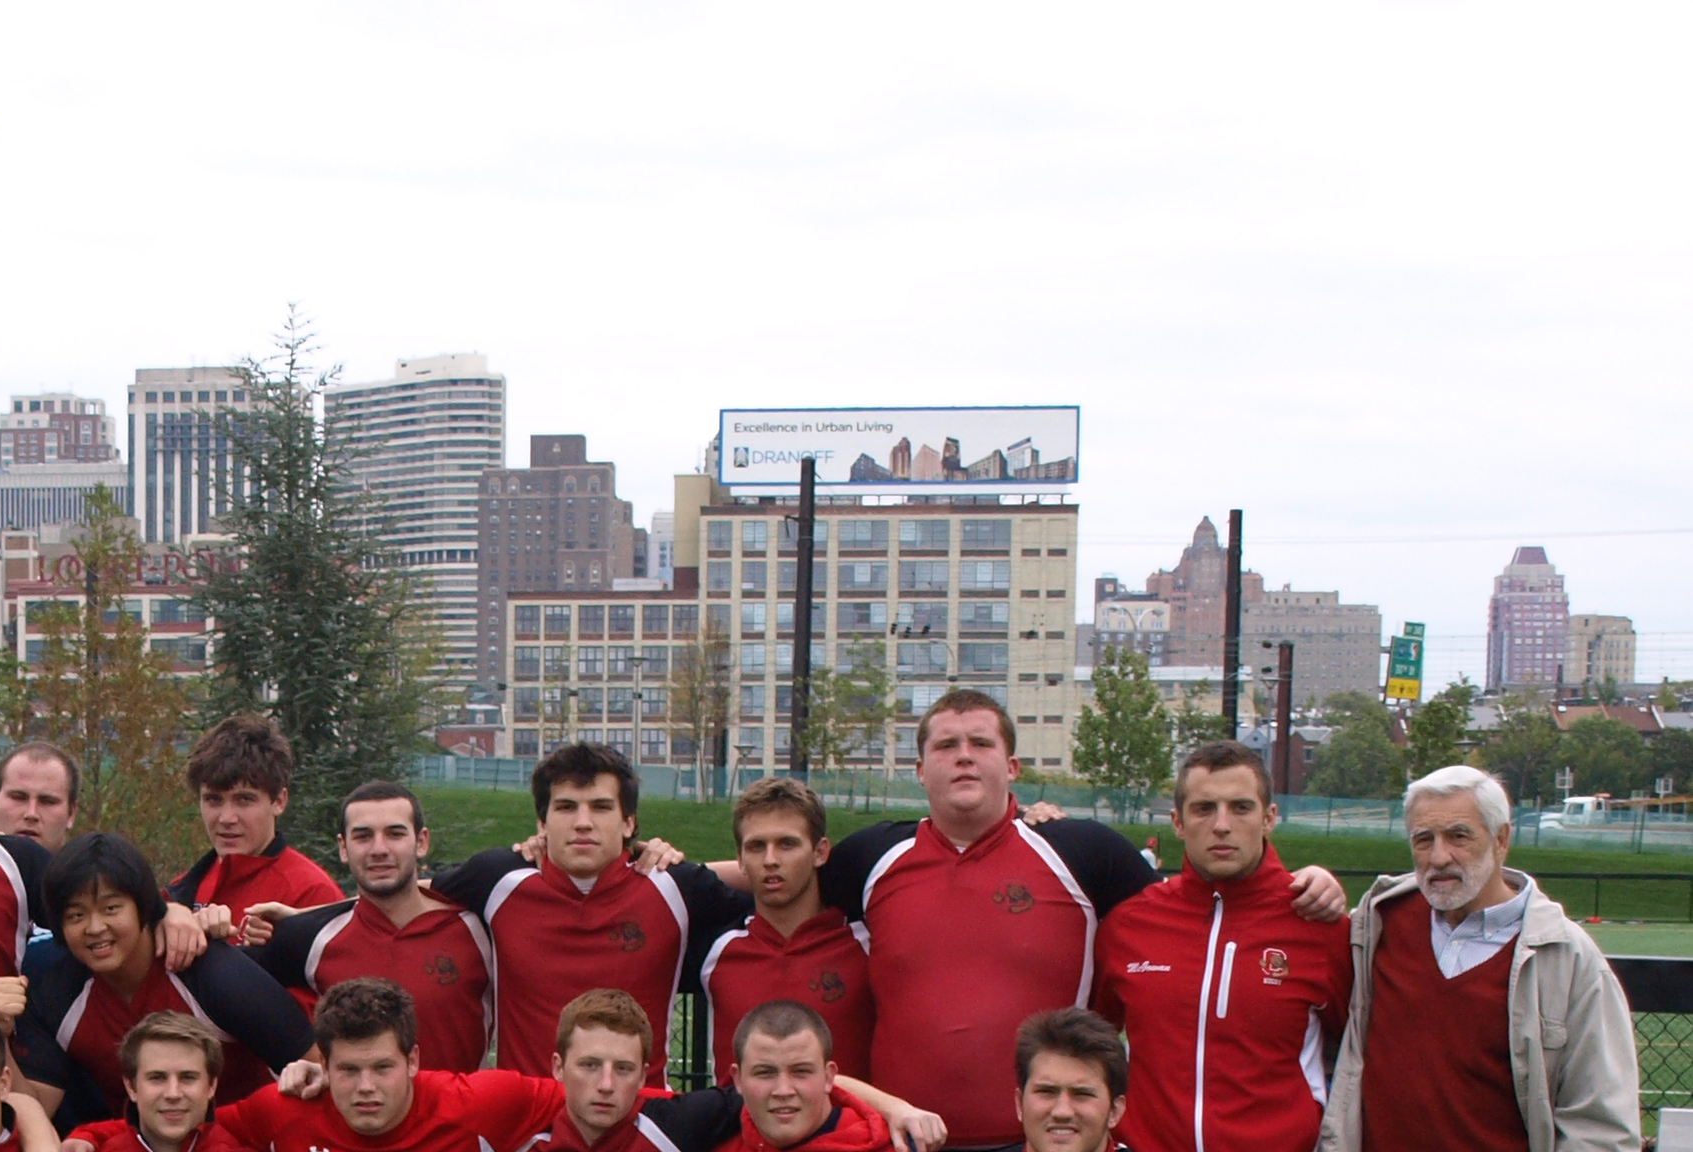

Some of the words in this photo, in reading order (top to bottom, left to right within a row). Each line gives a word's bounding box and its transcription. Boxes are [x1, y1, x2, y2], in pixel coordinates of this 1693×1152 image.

[734, 422, 798, 433] Excellence
[801, 422, 812, 433] in
[816, 421, 853, 433] Urban
[856, 421, 894, 434] Living
[752, 450, 835, 464] DRANOFF
